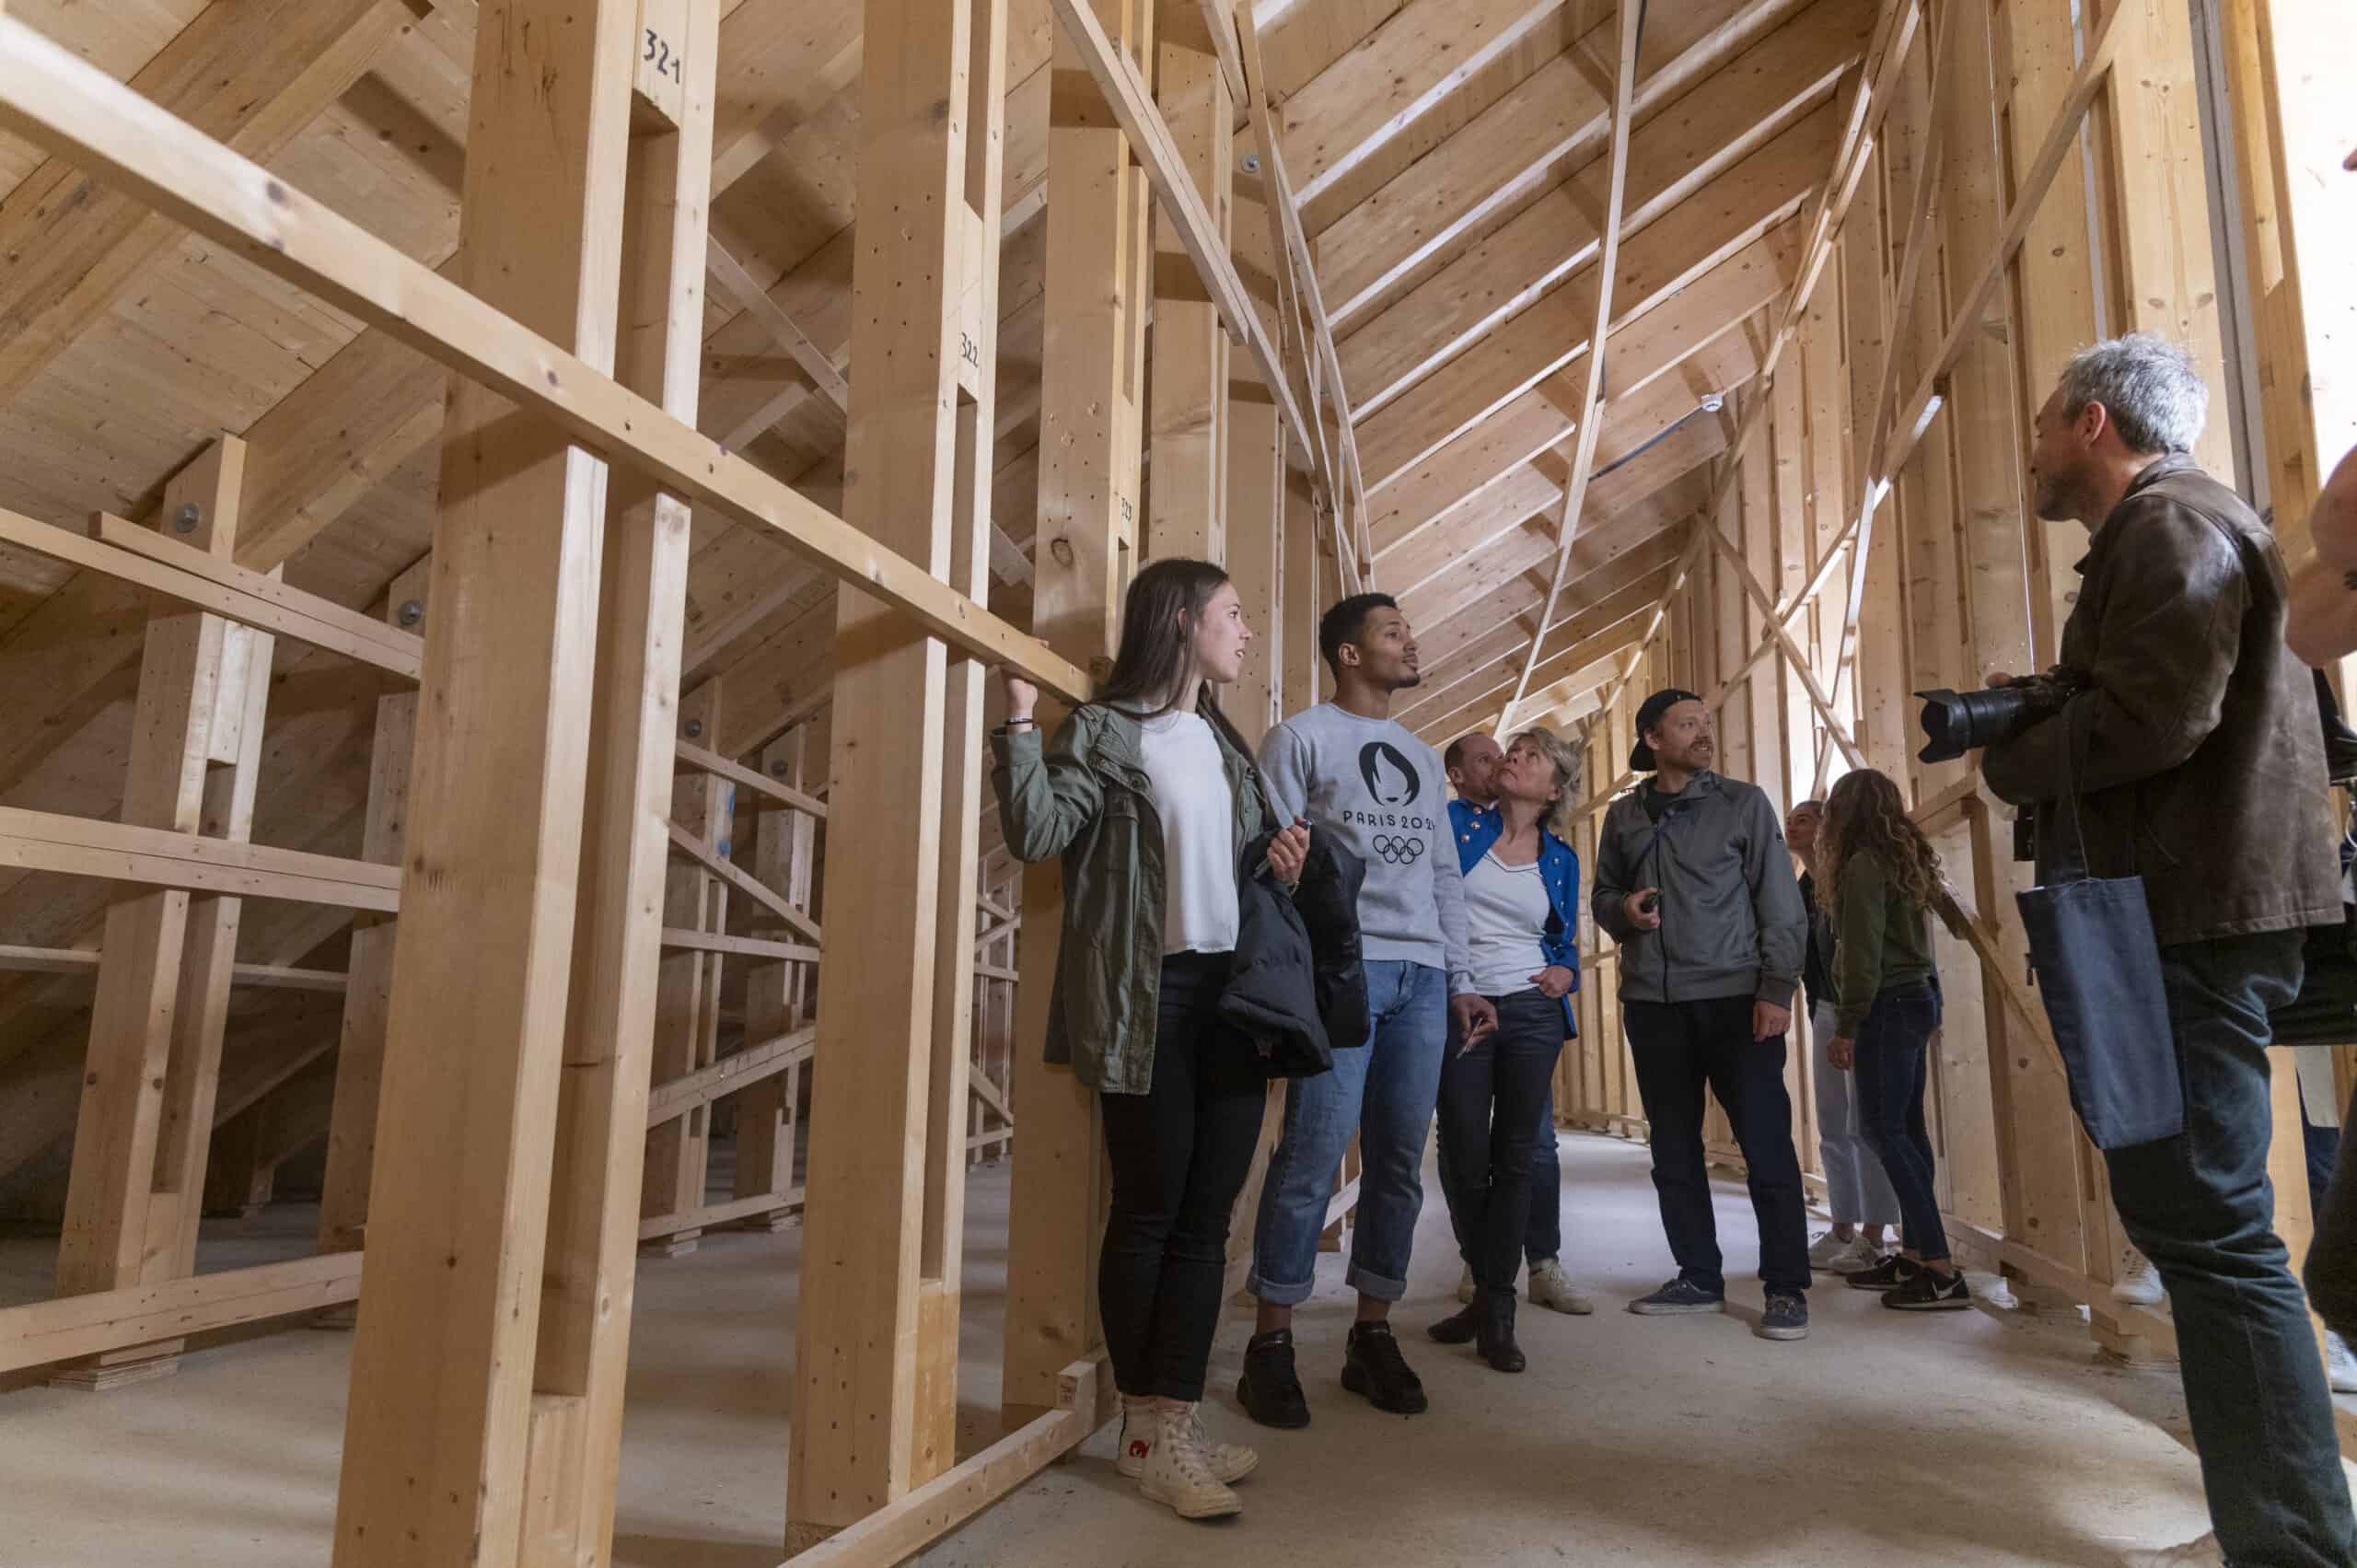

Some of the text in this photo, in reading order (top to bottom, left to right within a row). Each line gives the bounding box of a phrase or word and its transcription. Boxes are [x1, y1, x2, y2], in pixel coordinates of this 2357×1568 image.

[644, 29, 679, 84] 321
[961, 331, 978, 368] 322
[1343, 810, 1396, 827] PARIS
